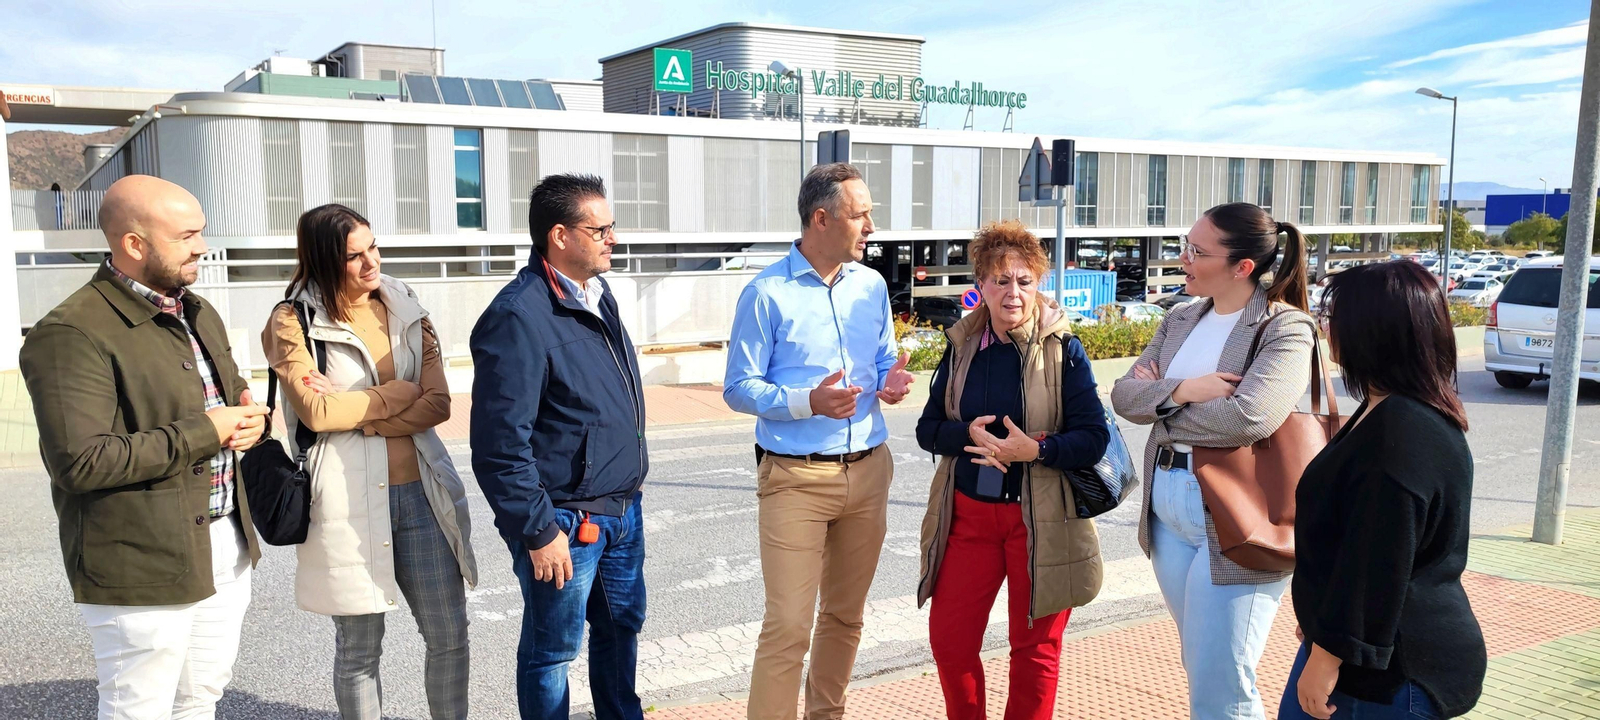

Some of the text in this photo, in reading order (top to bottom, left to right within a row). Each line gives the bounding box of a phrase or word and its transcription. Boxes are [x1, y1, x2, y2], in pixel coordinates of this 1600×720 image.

[706, 60, 1027, 109] Hospital Valle del Guadalhorce
